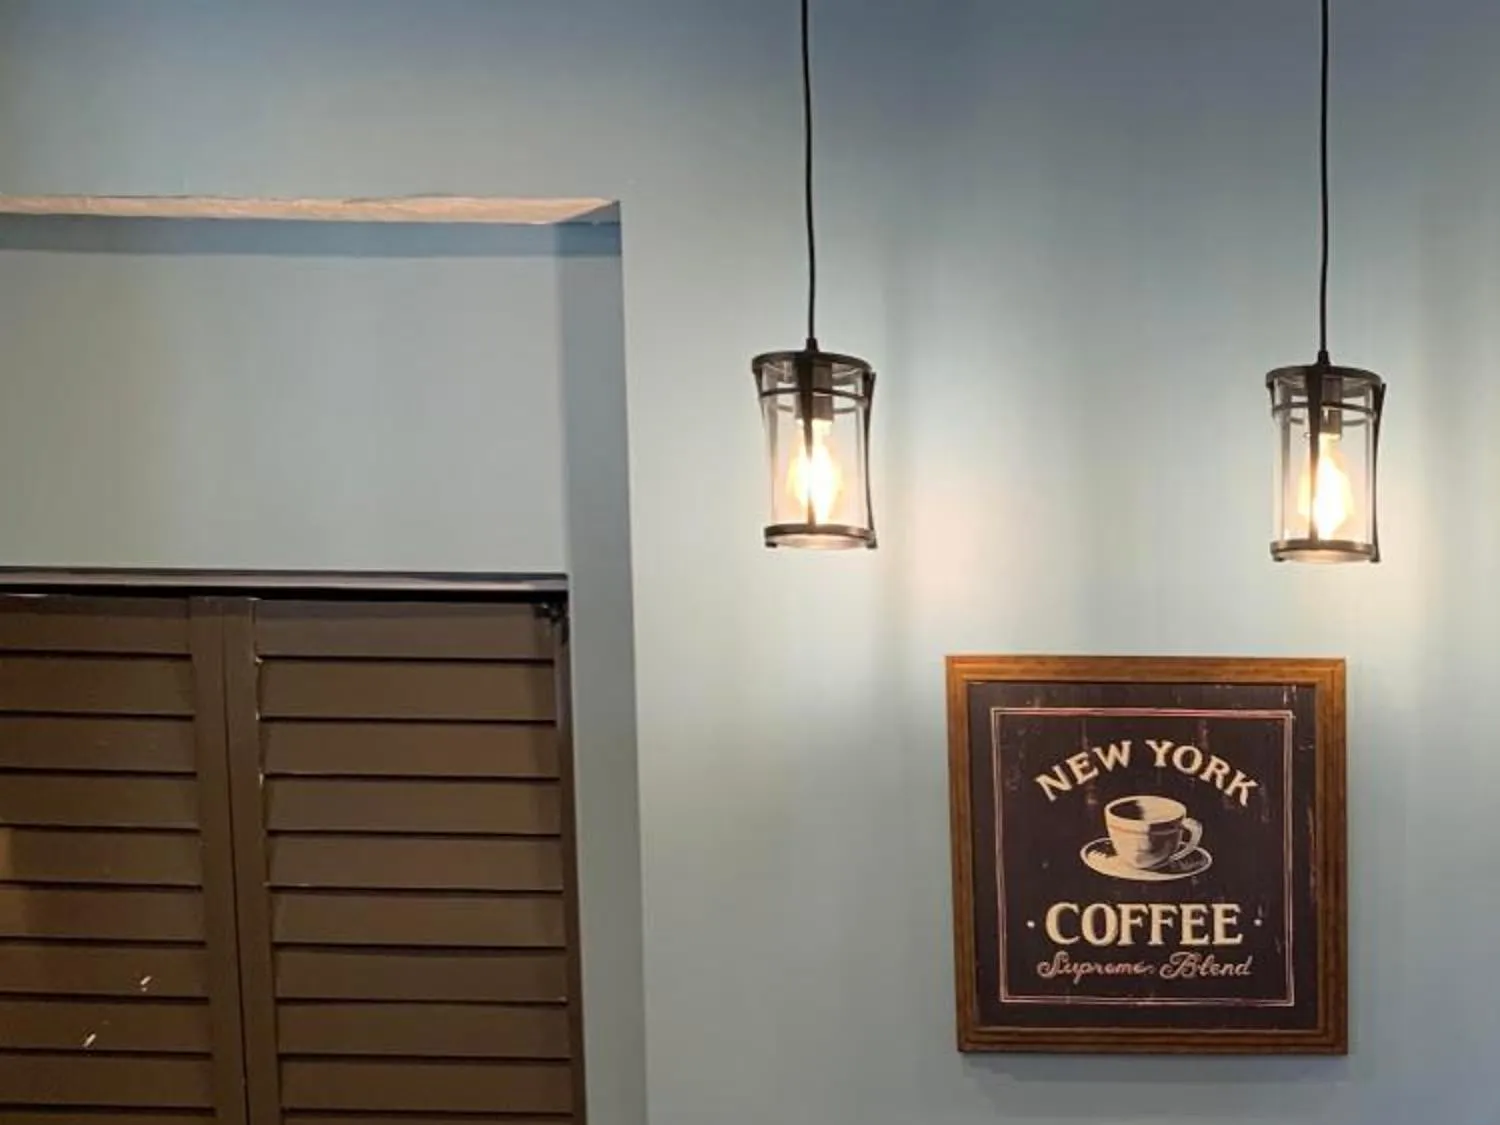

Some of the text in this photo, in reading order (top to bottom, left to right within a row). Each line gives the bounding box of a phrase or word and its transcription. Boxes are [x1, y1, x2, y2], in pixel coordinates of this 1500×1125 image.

[1035, 739, 1261, 806] NEW YORK
[1045, 902, 1243, 946] COFFEE
[1037, 951, 1253, 984] Supreme Blend
